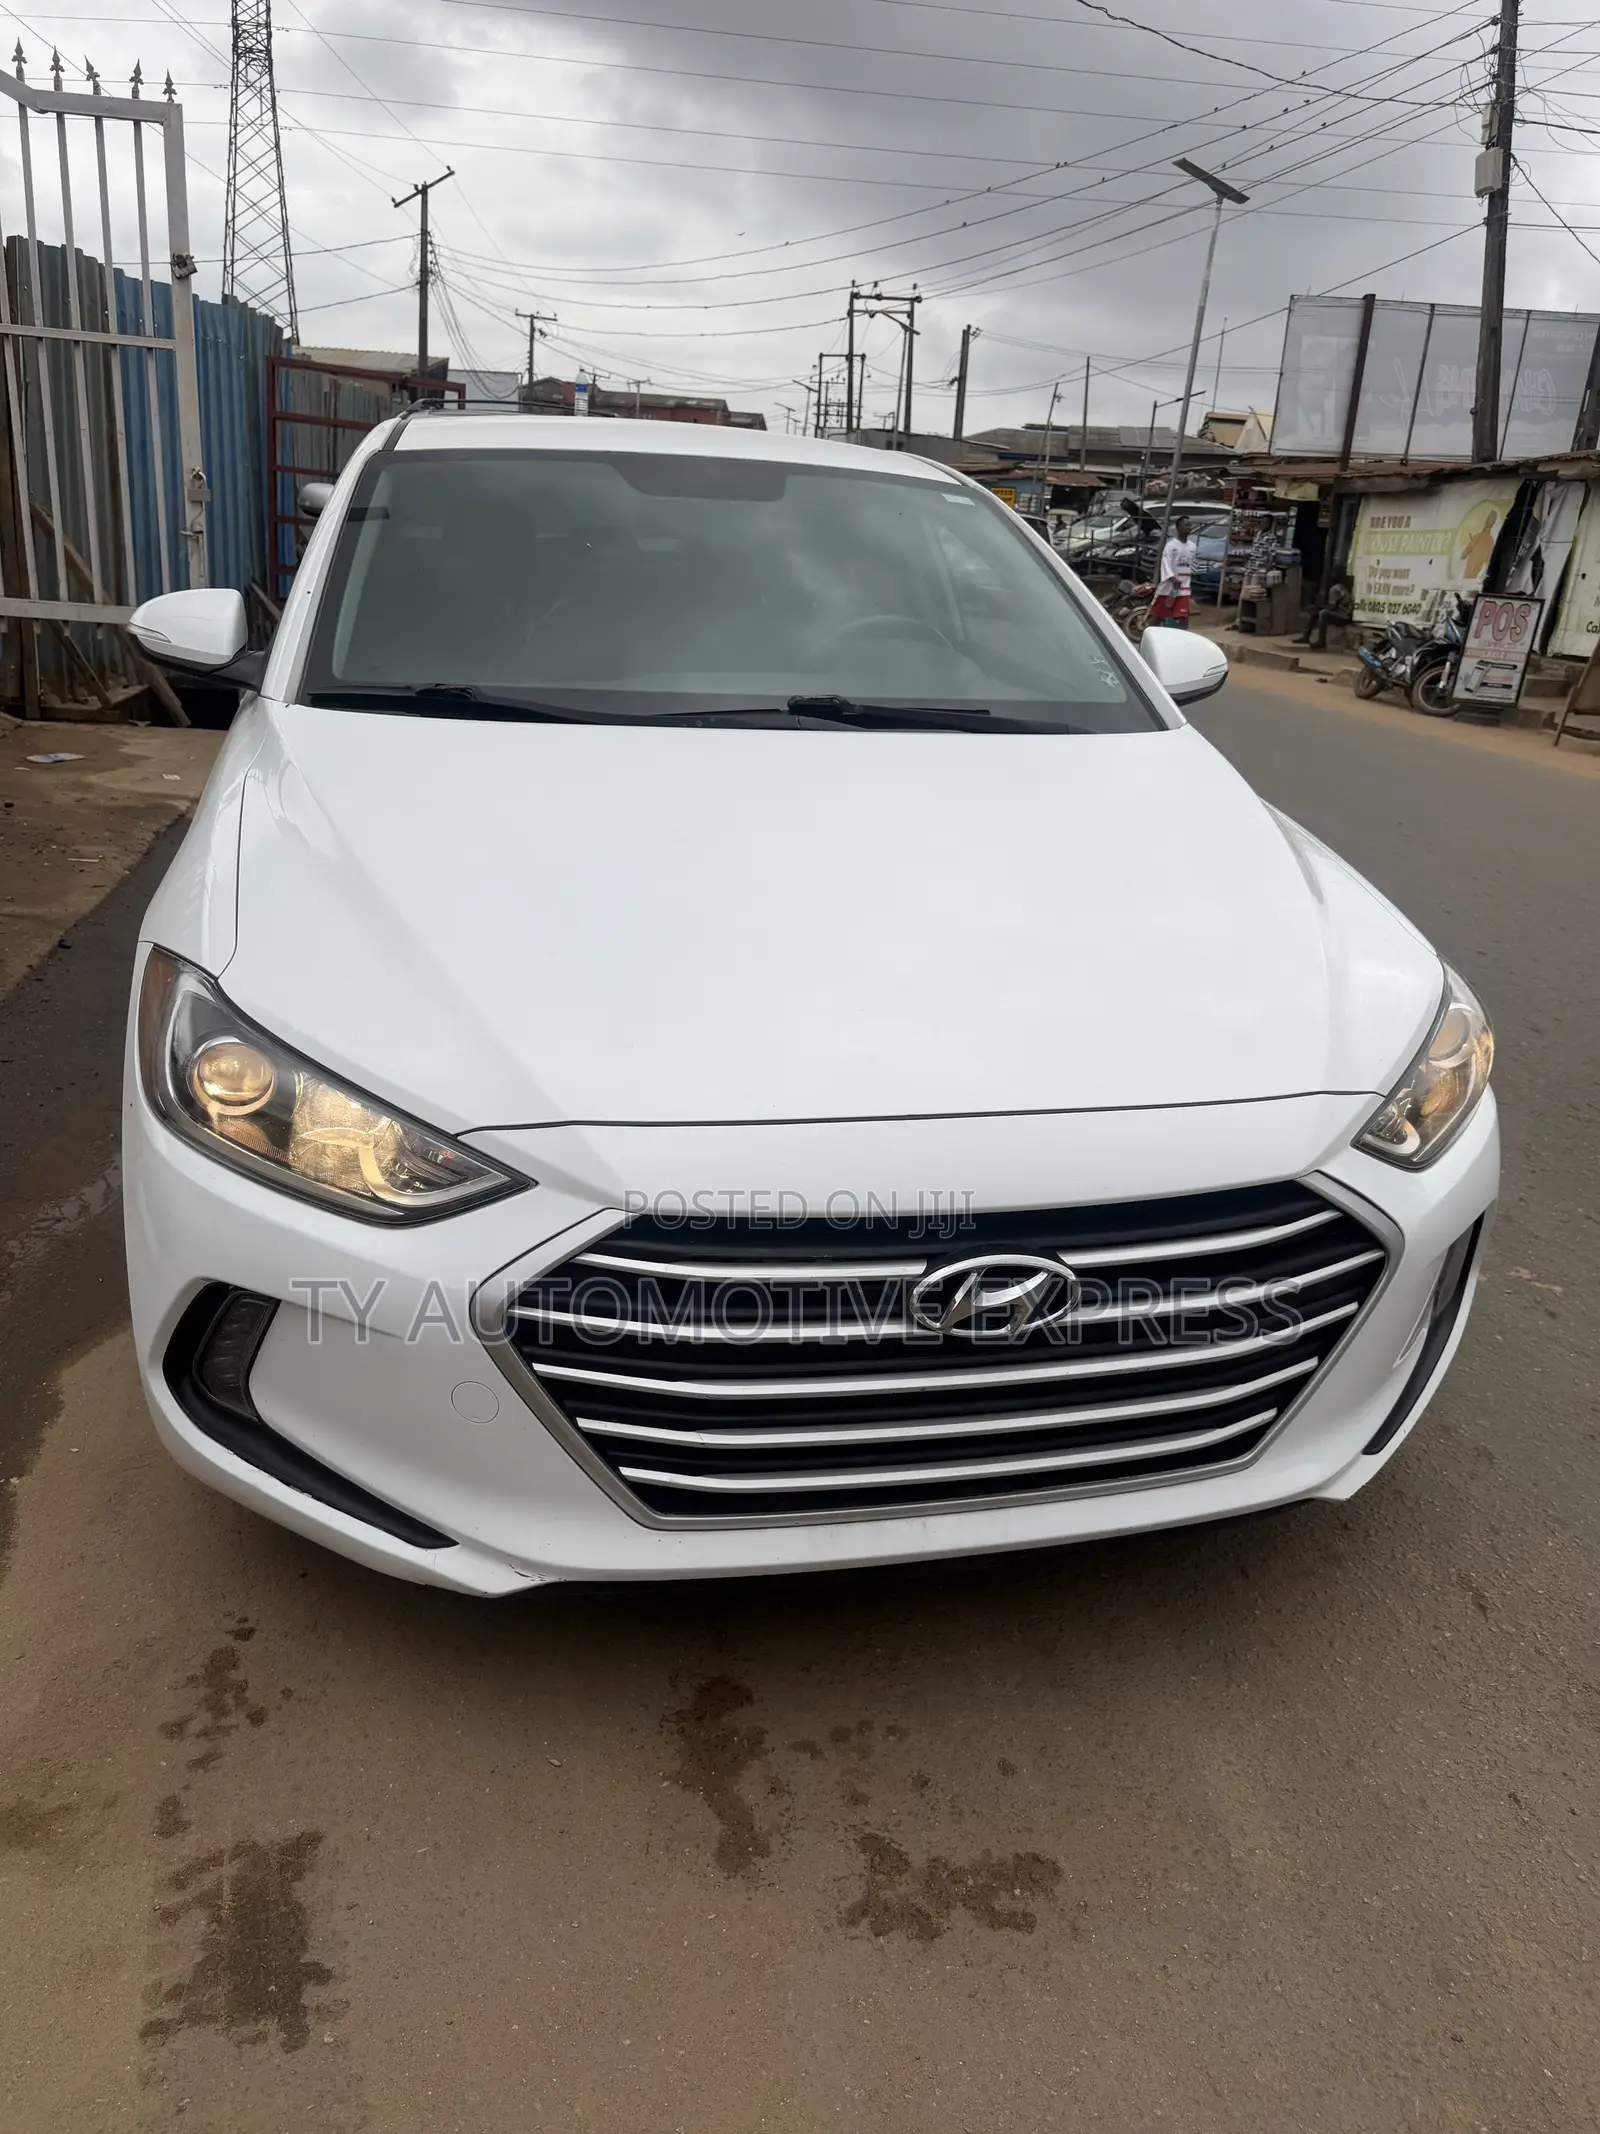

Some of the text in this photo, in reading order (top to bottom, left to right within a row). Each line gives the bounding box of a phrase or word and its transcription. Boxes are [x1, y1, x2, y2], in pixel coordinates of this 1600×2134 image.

[1370, 516, 1412, 529] ARE YOU A
[1474, 600, 1532, 643] POS
